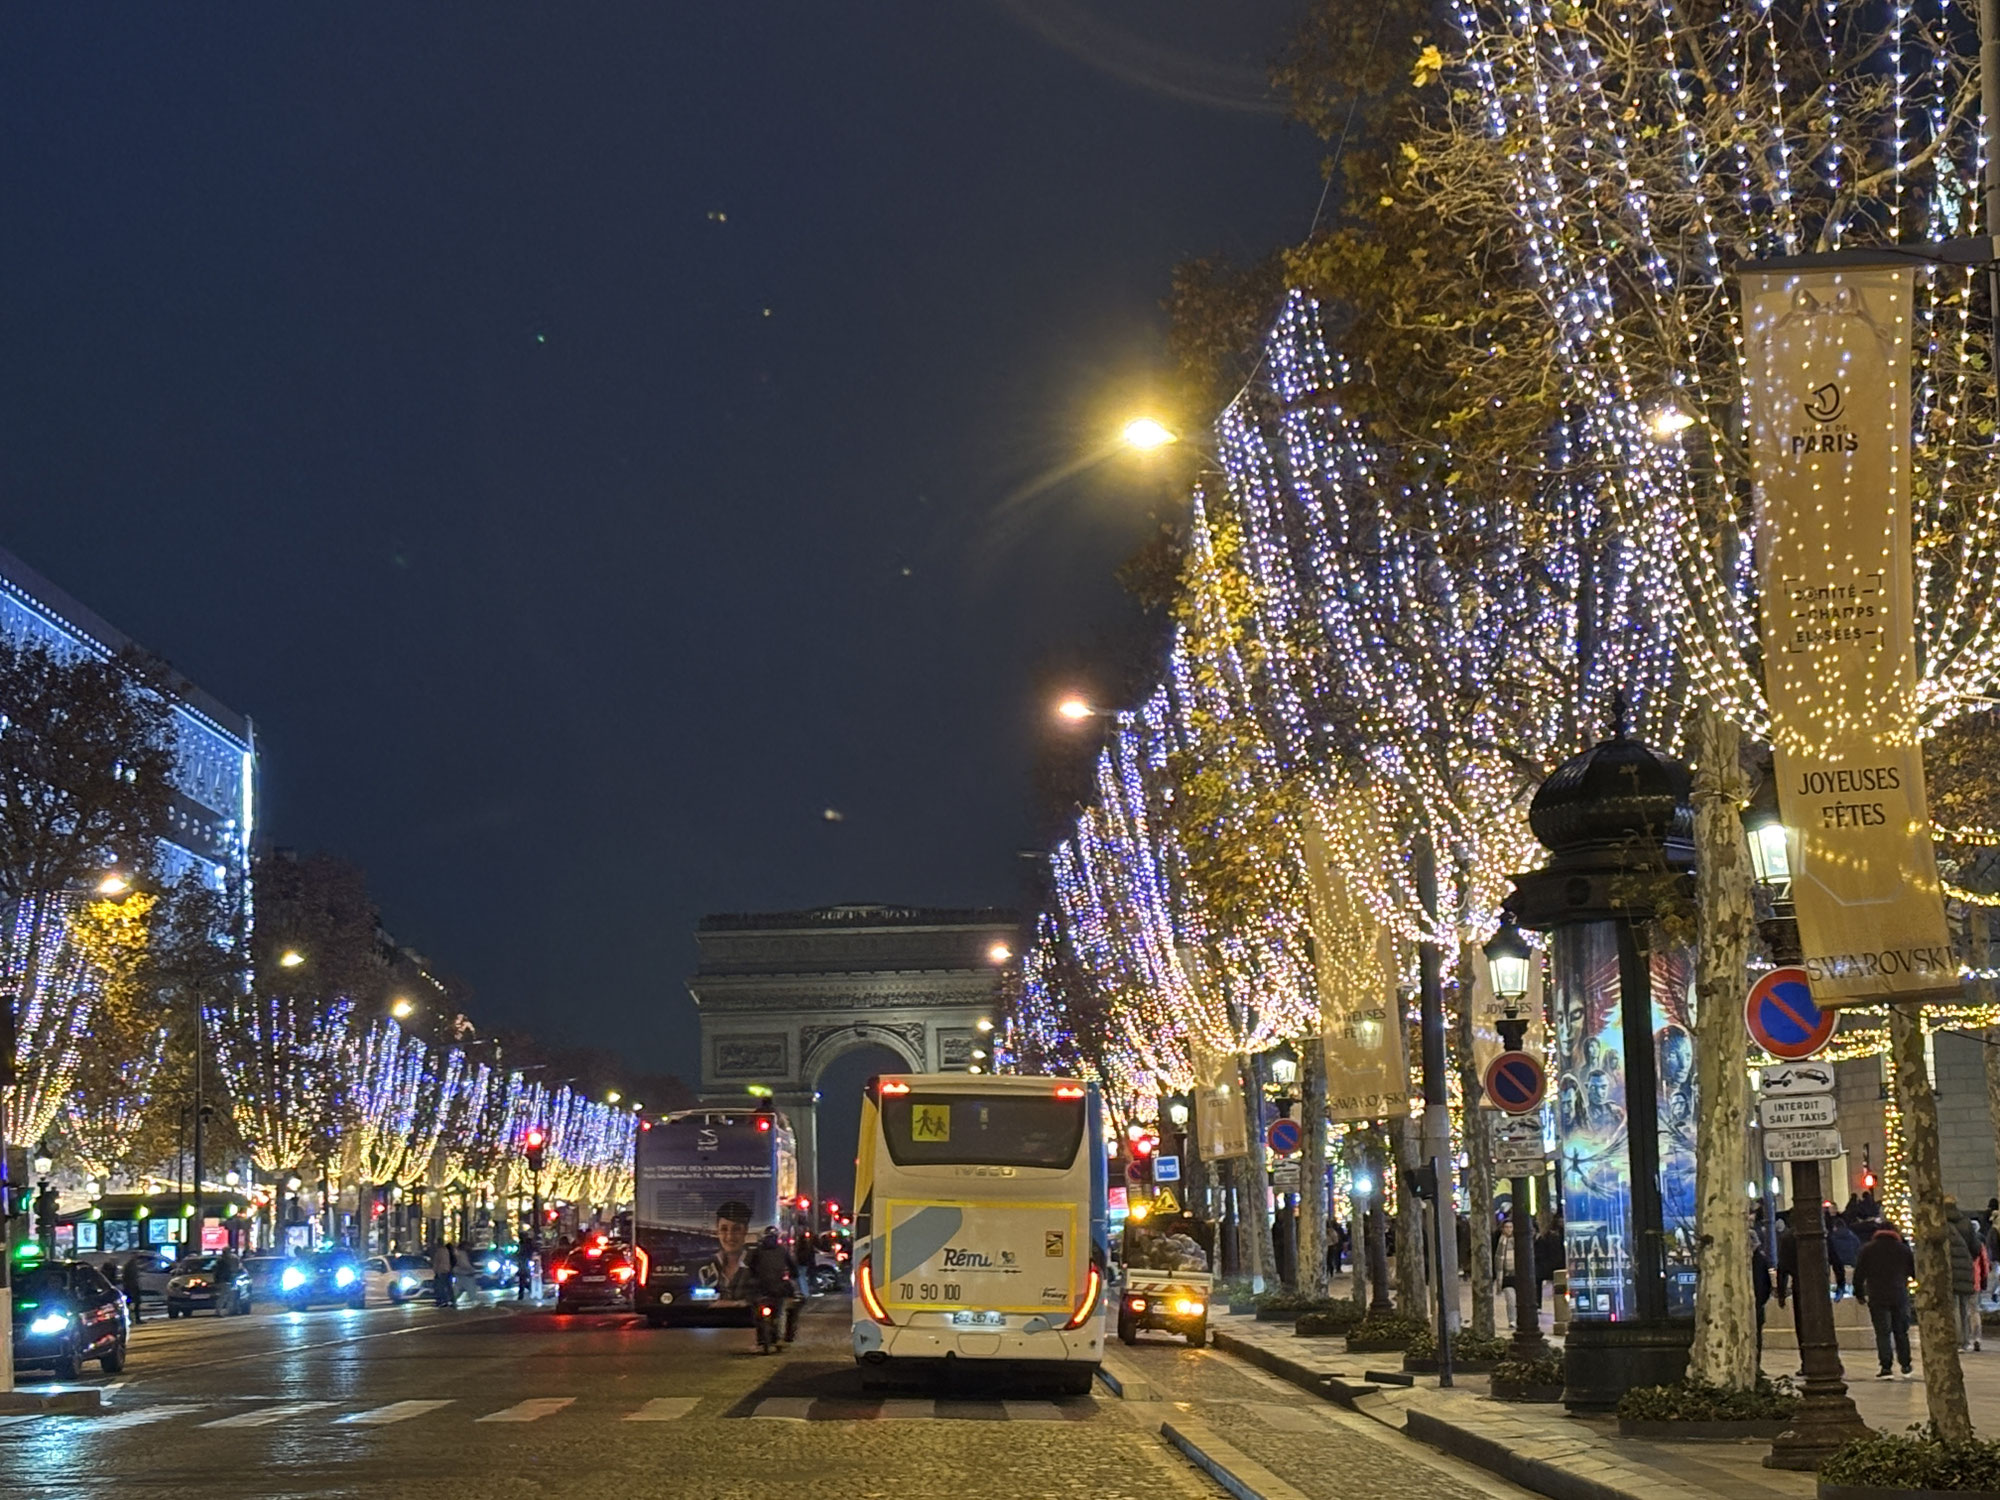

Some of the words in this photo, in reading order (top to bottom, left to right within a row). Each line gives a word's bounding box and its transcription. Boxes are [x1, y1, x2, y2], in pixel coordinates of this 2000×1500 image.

[1802, 425, 1830, 433] VIE
[1792, 433, 1858, 454] PARIS
[1808, 606, 1874, 620] CHAMPS
[1798, 767, 1900, 795] JOYEUSES
[1822, 801, 1886, 828] FÊTES
[1806, 946, 1956, 982] SWAROVSKI
[1483, 1002, 1533, 1015] JOYES
[1774, 1101, 1819, 1112] INTERDIT
[1769, 1114, 1795, 1124] SAUF
[1800, 1112, 1828, 1122] TAXIS
[954, 1166, 1015, 1178] IVECO
[943, 1248, 993, 1268] Rémi
[900, 1283, 914, 1300] 70
[920, 1283, 938, 1300] 90
[944, 1284, 961, 1301] 100
